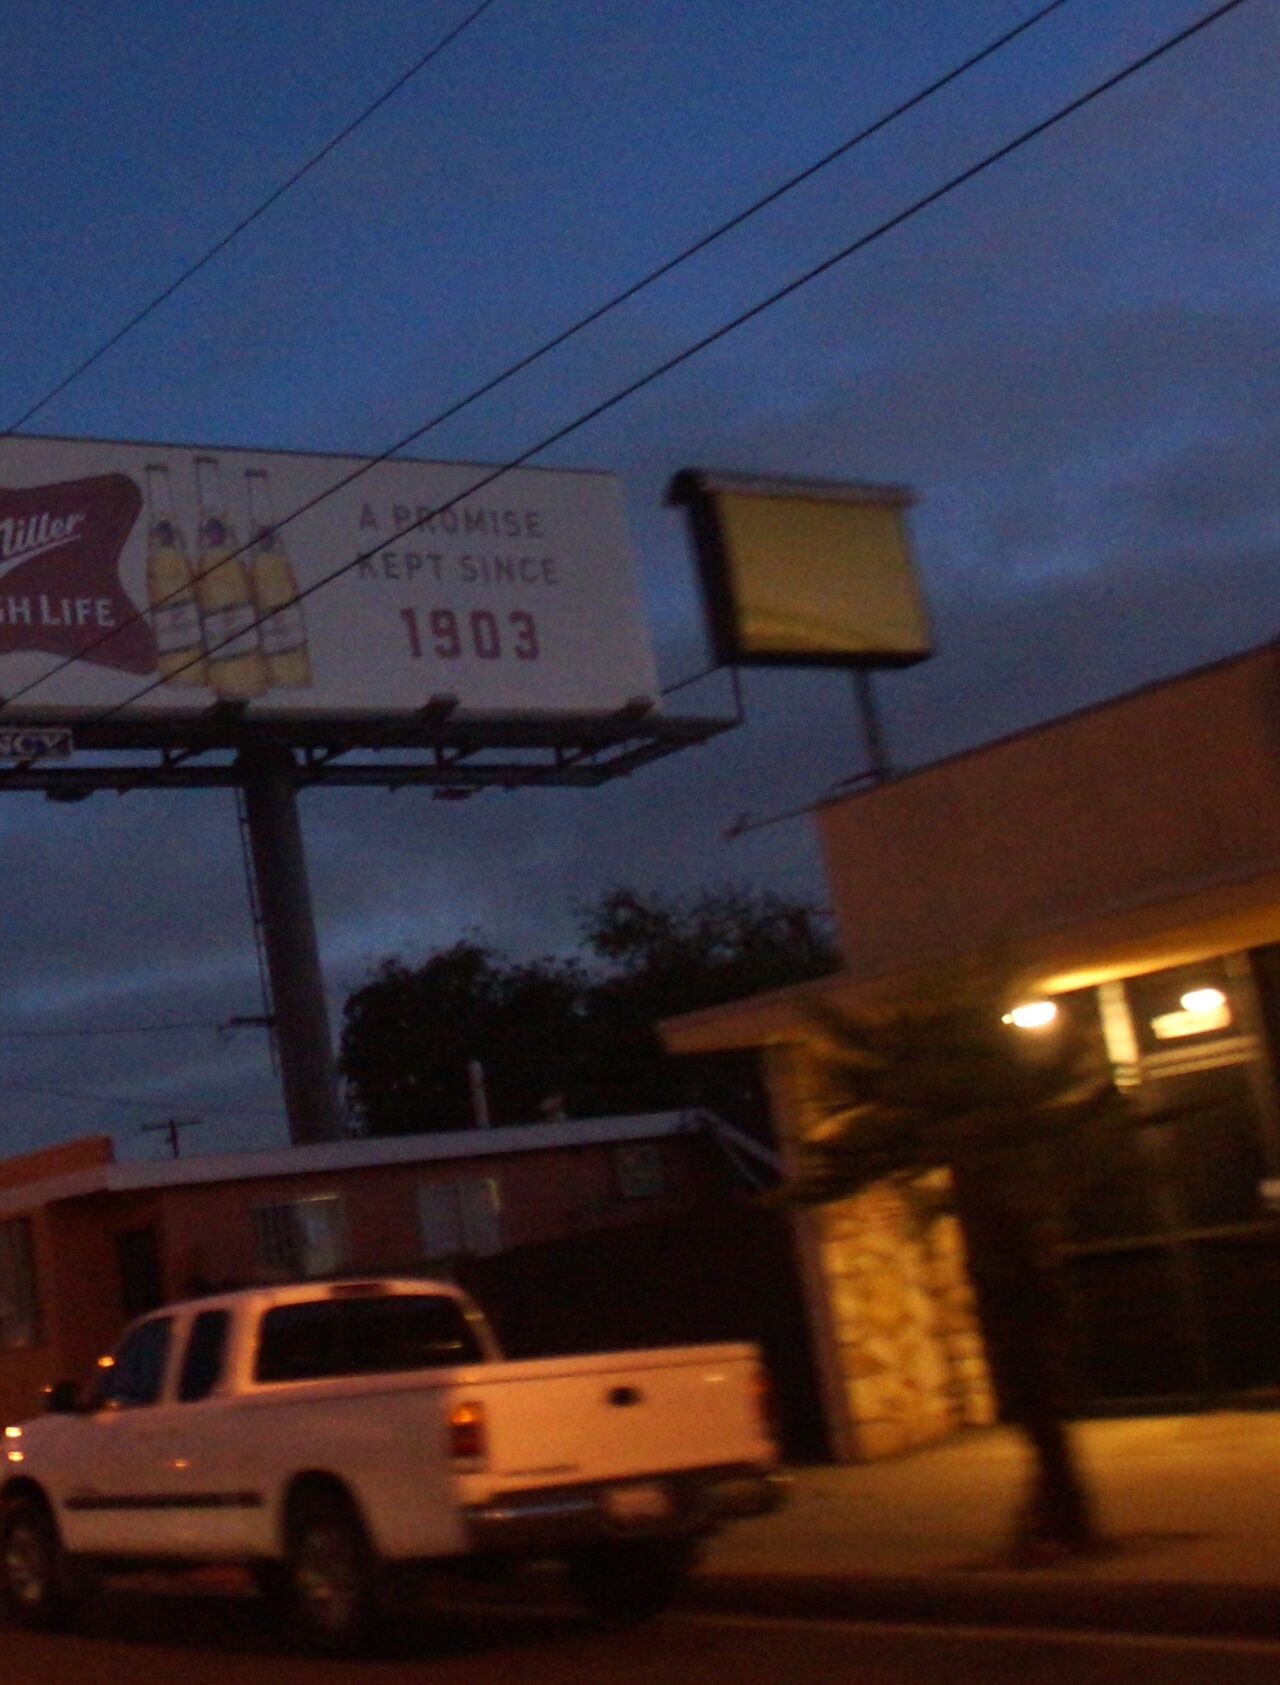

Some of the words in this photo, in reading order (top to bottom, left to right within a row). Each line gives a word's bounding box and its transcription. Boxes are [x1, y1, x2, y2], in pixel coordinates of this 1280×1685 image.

[359, 504, 377, 530] A
[393, 505, 544, 538] PROMISE
[357, 553, 444, 581] KEPT
[460, 555, 560, 585] SINCE
[40, 595, 116, 627] LIFE
[400, 608, 540, 660] 1903
